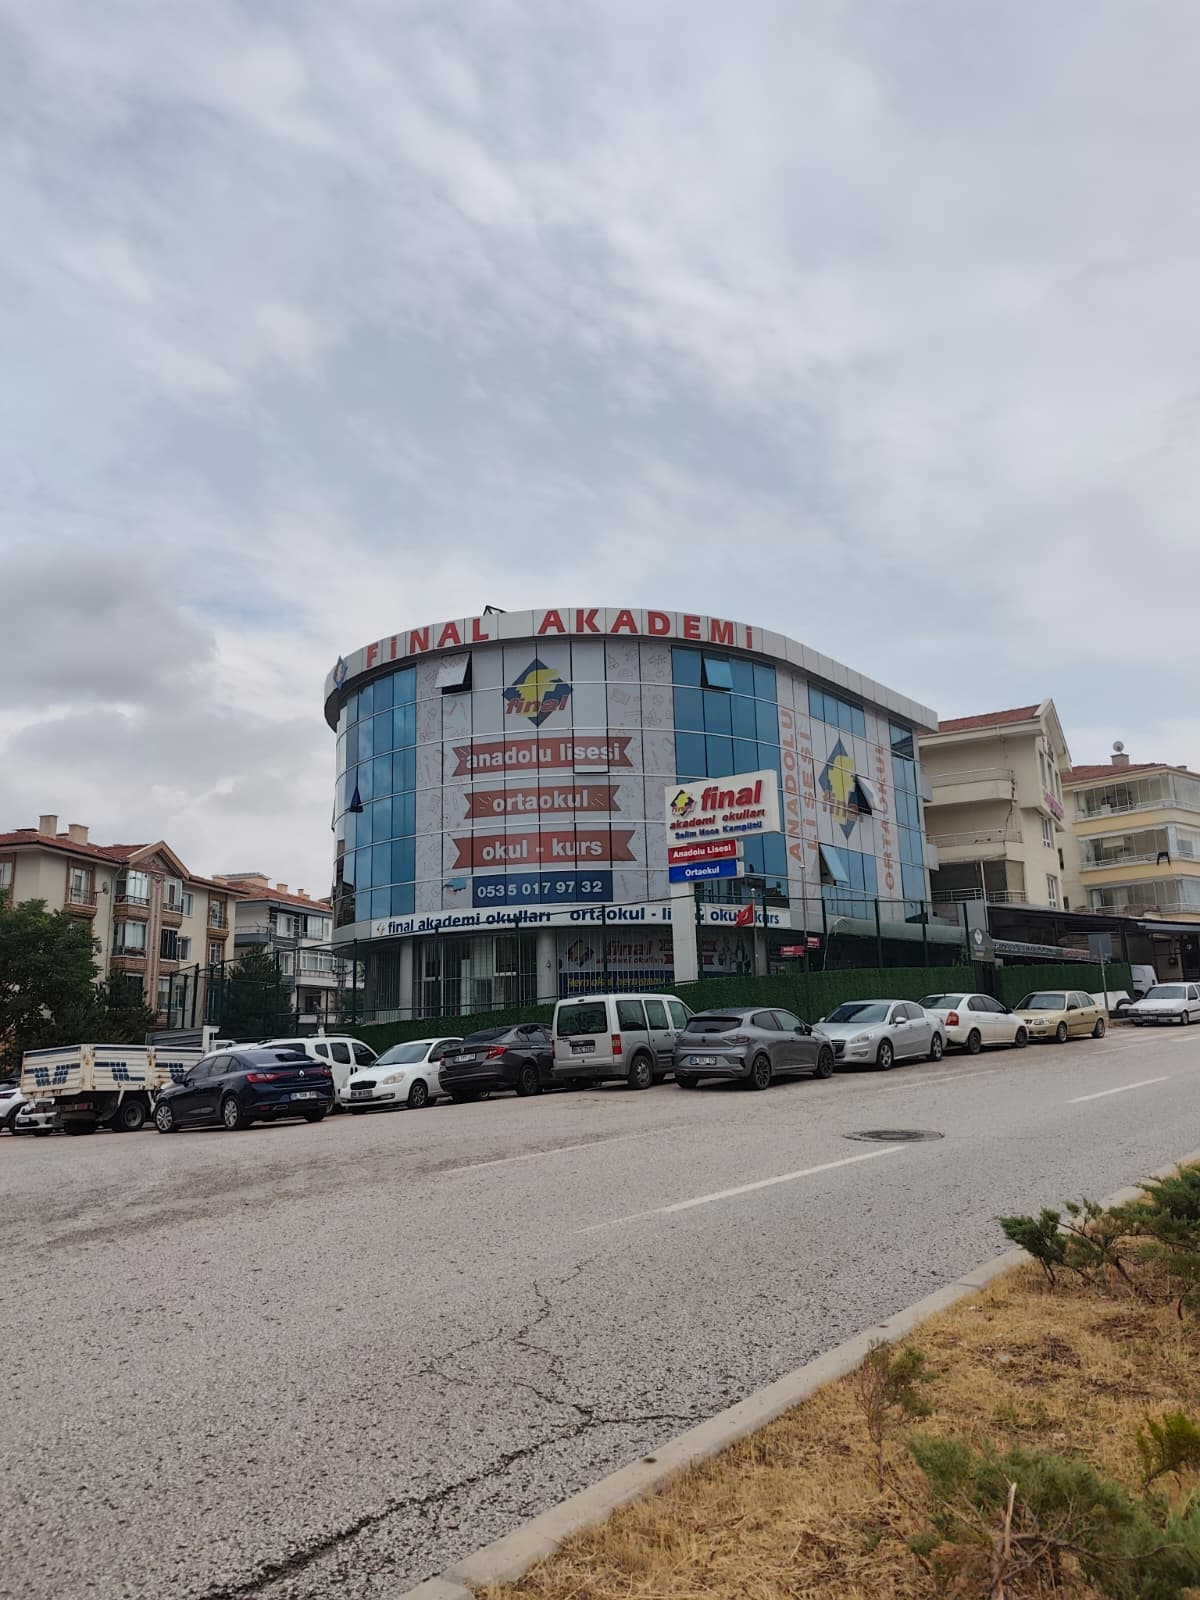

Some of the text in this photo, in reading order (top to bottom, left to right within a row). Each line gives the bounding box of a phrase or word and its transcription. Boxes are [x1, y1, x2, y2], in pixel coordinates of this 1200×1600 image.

[506, 695, 569, 714] final
[466, 743, 620, 769] anadolu lisesi
[701, 780, 763, 811] final
[781, 710, 803, 863] ANADOLU
[493, 789, 589, 812] ortaokul
[482, 840, 528, 861] okul
[552, 838, 603, 857] kurs
[673, 844, 732, 858] Anadolu Lisesi
[685, 866, 720, 877] Ortaokul
[477, 881, 603, 898] 0535 017 97 32
[388, 920, 414, 934] final
[418, 912, 481, 932] akademi
